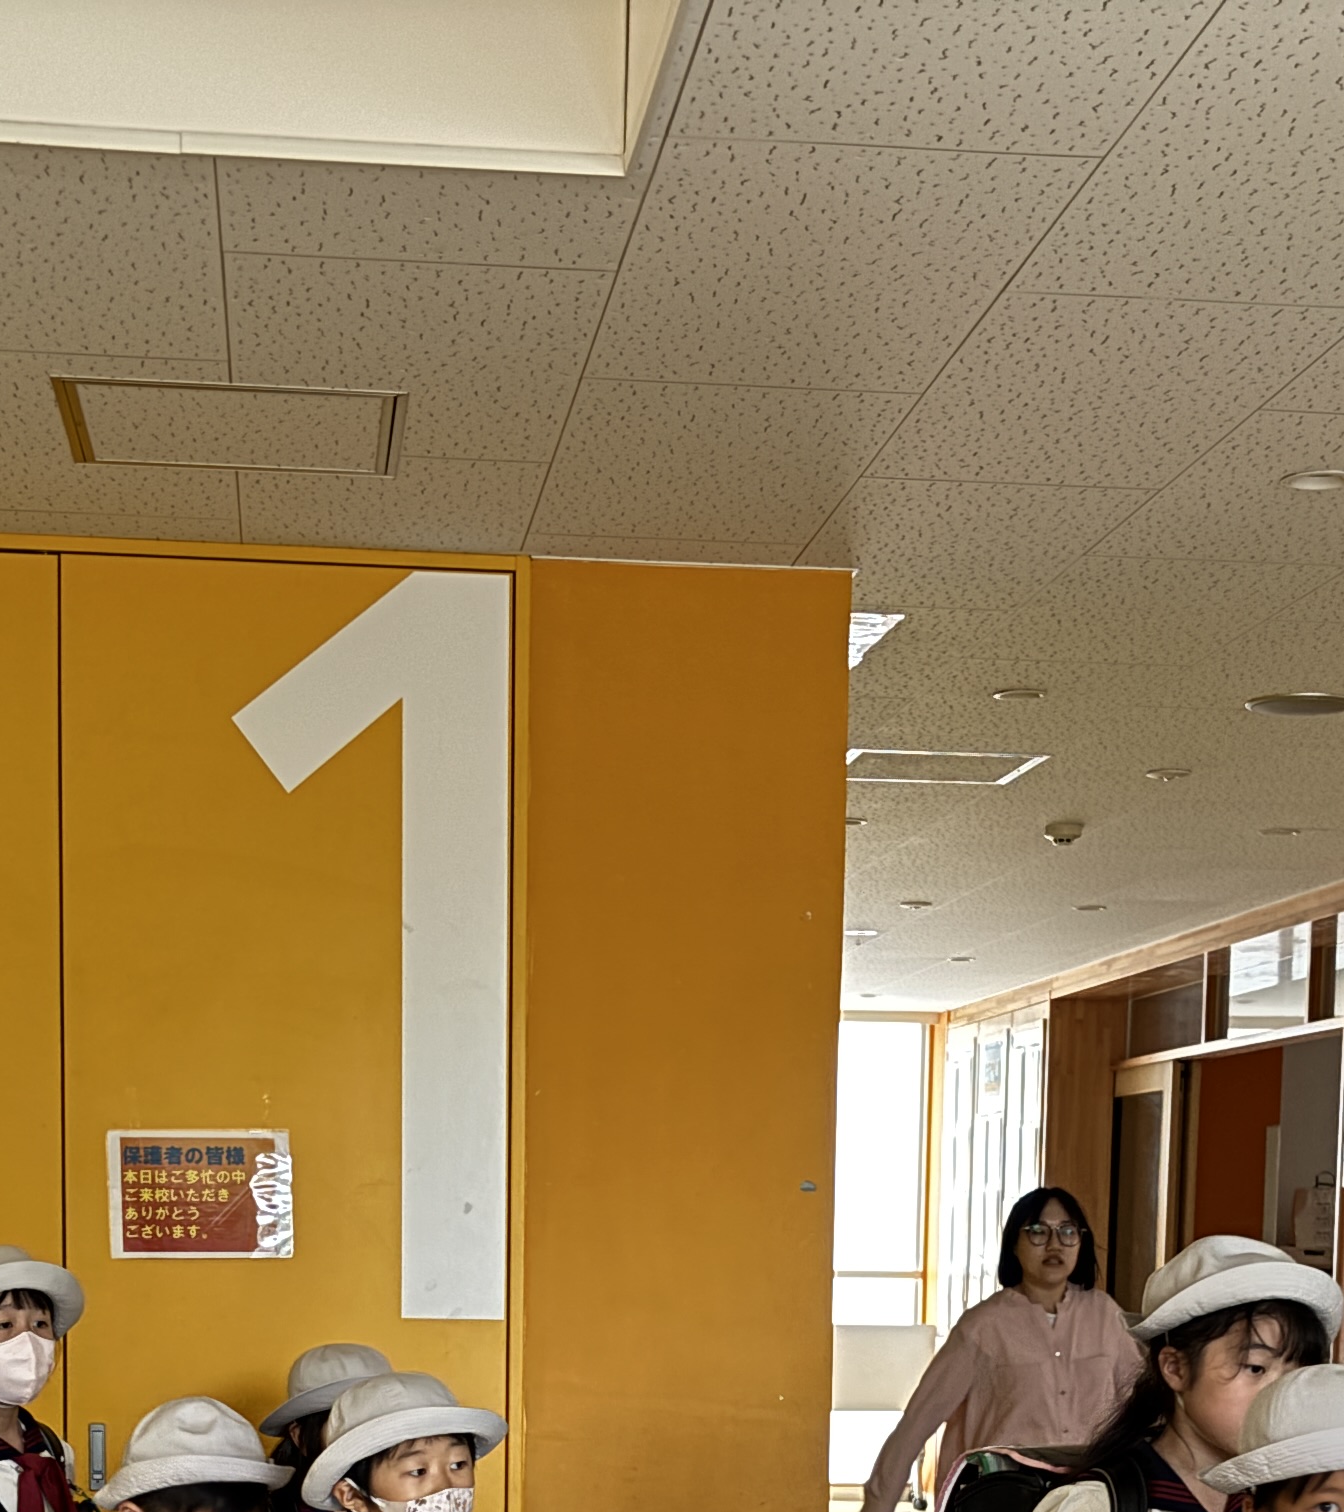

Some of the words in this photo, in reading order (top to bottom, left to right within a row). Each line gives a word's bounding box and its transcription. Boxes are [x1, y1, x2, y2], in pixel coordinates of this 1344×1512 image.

[231, 570, 510, 1320] 1
[123, 1145, 246, 1166] 保護者の皆様
[123, 1169, 246, 1185] 本日はご多忙の中
[124, 1188, 231, 1203] ご来校いただき
[125, 1206, 201, 1221] ありがとう
[125, 1224, 209, 1240] ございます。
